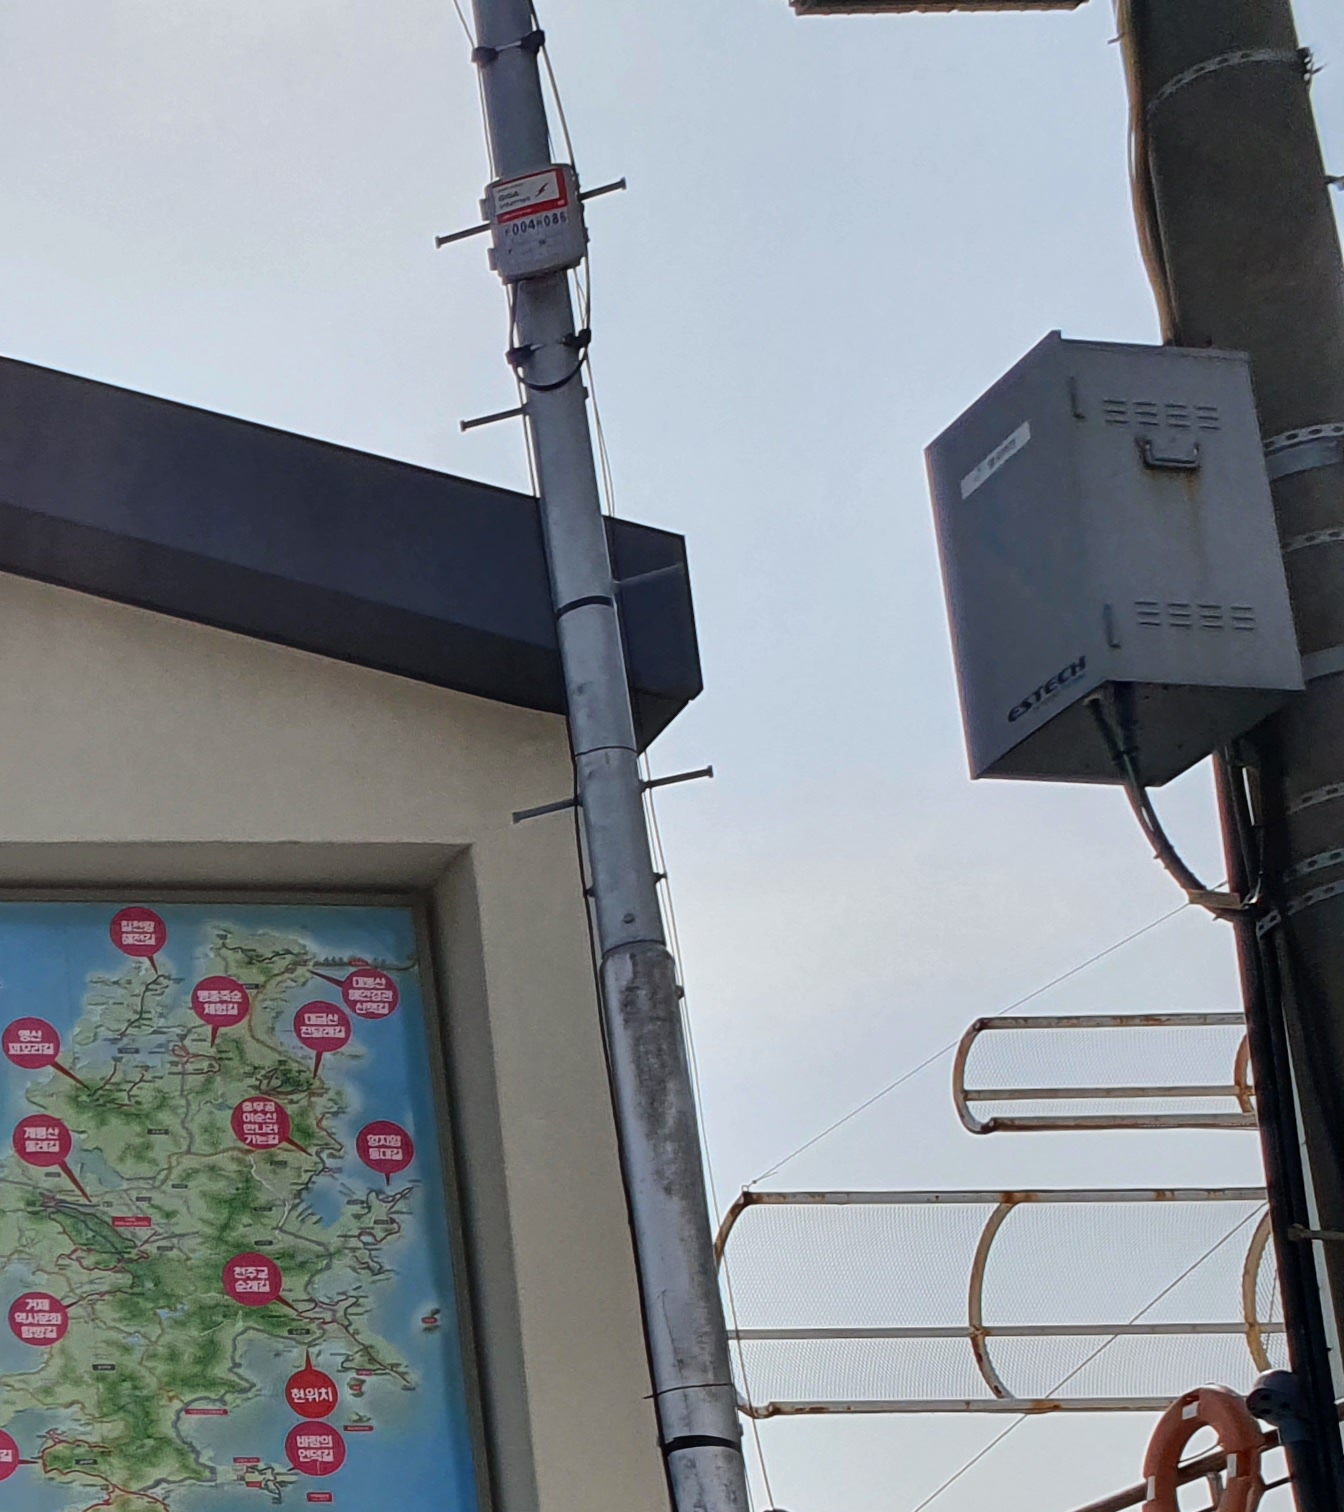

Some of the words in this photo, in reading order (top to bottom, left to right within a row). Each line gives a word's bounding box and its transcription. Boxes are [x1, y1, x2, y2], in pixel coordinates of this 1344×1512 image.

[243, 1113, 276, 1122] 이순신
[234, 1267, 268, 1278] 천주교
[25, 1299, 49, 1310] 거제
[291, 1387, 333, 1403] 현위치
[296, 1435, 333, 1448] 바람의
[298, 1449, 334, 1462] 언덕길
